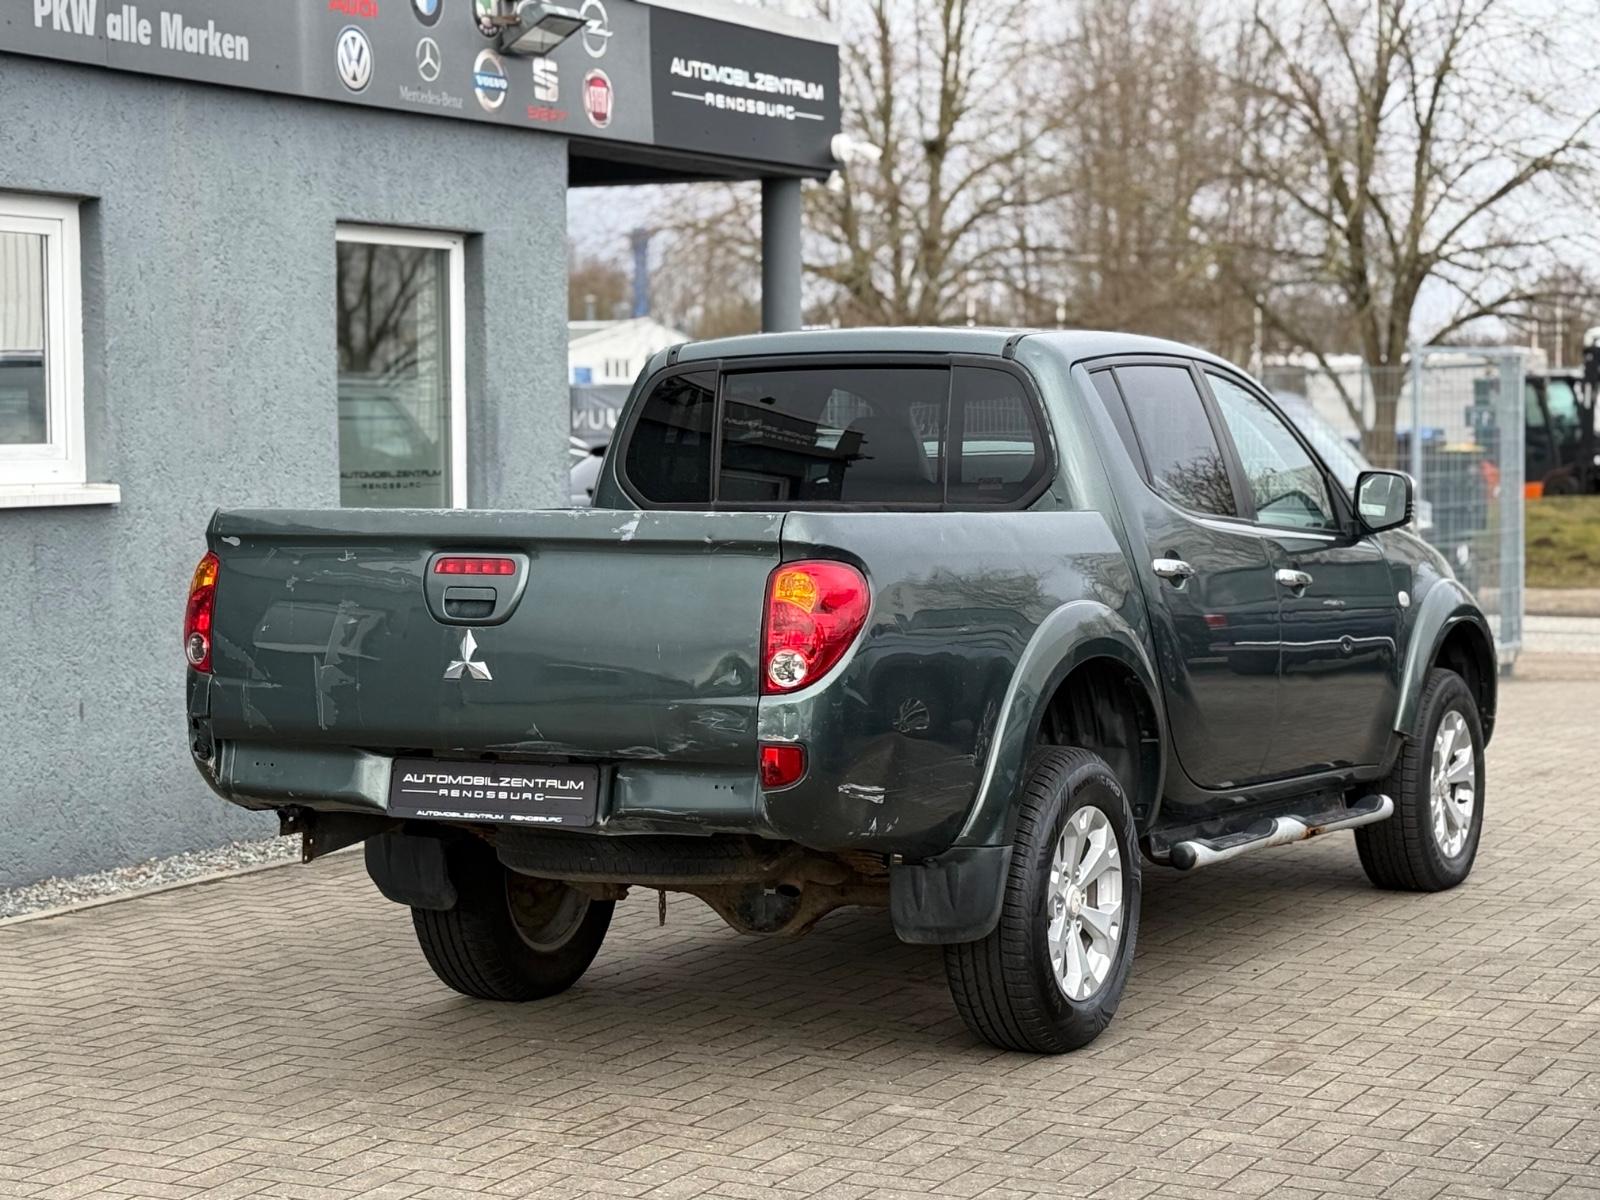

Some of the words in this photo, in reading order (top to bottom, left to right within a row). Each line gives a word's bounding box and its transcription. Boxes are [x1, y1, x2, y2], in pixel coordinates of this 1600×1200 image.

[34, 0, 97, 36] PKW
[106, 4, 152, 45] alle
[160, 11, 249, 62] Marken
[670, 57, 824, 101] AUTOMOBILZENTRUM
[705, 92, 796, 120] RENDSBURG
[402, 773, 584, 790] AUTOMOBILZENTRUM
[438, 788, 545, 801] RENDSBURG
[416, 810, 504, 820] AUTOMOBILZENTRUM
[510, 814, 562, 823] RENDSBURG
